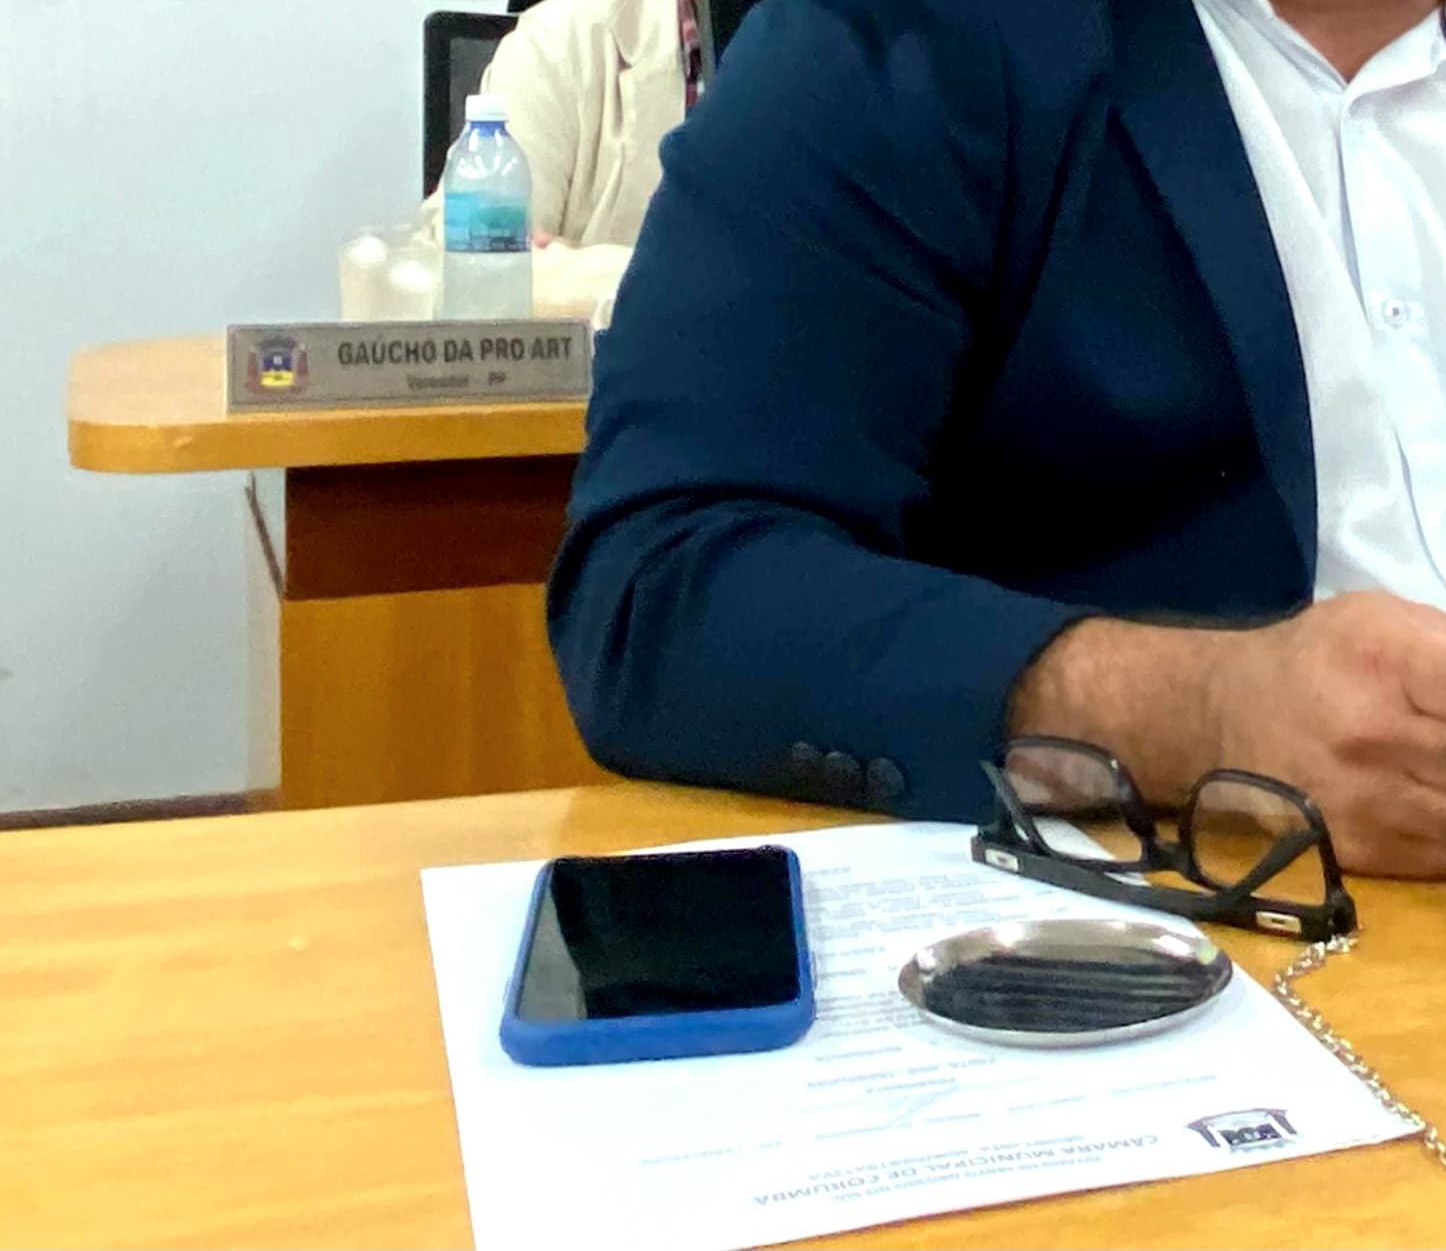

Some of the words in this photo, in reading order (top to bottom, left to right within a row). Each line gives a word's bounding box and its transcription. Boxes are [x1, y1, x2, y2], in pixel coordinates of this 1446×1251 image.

[338, 335, 437, 365] GAÚCHO
[444, 339, 473, 362] DA
[480, 337, 525, 361] PRO
[531, 337, 572, 360] ART
